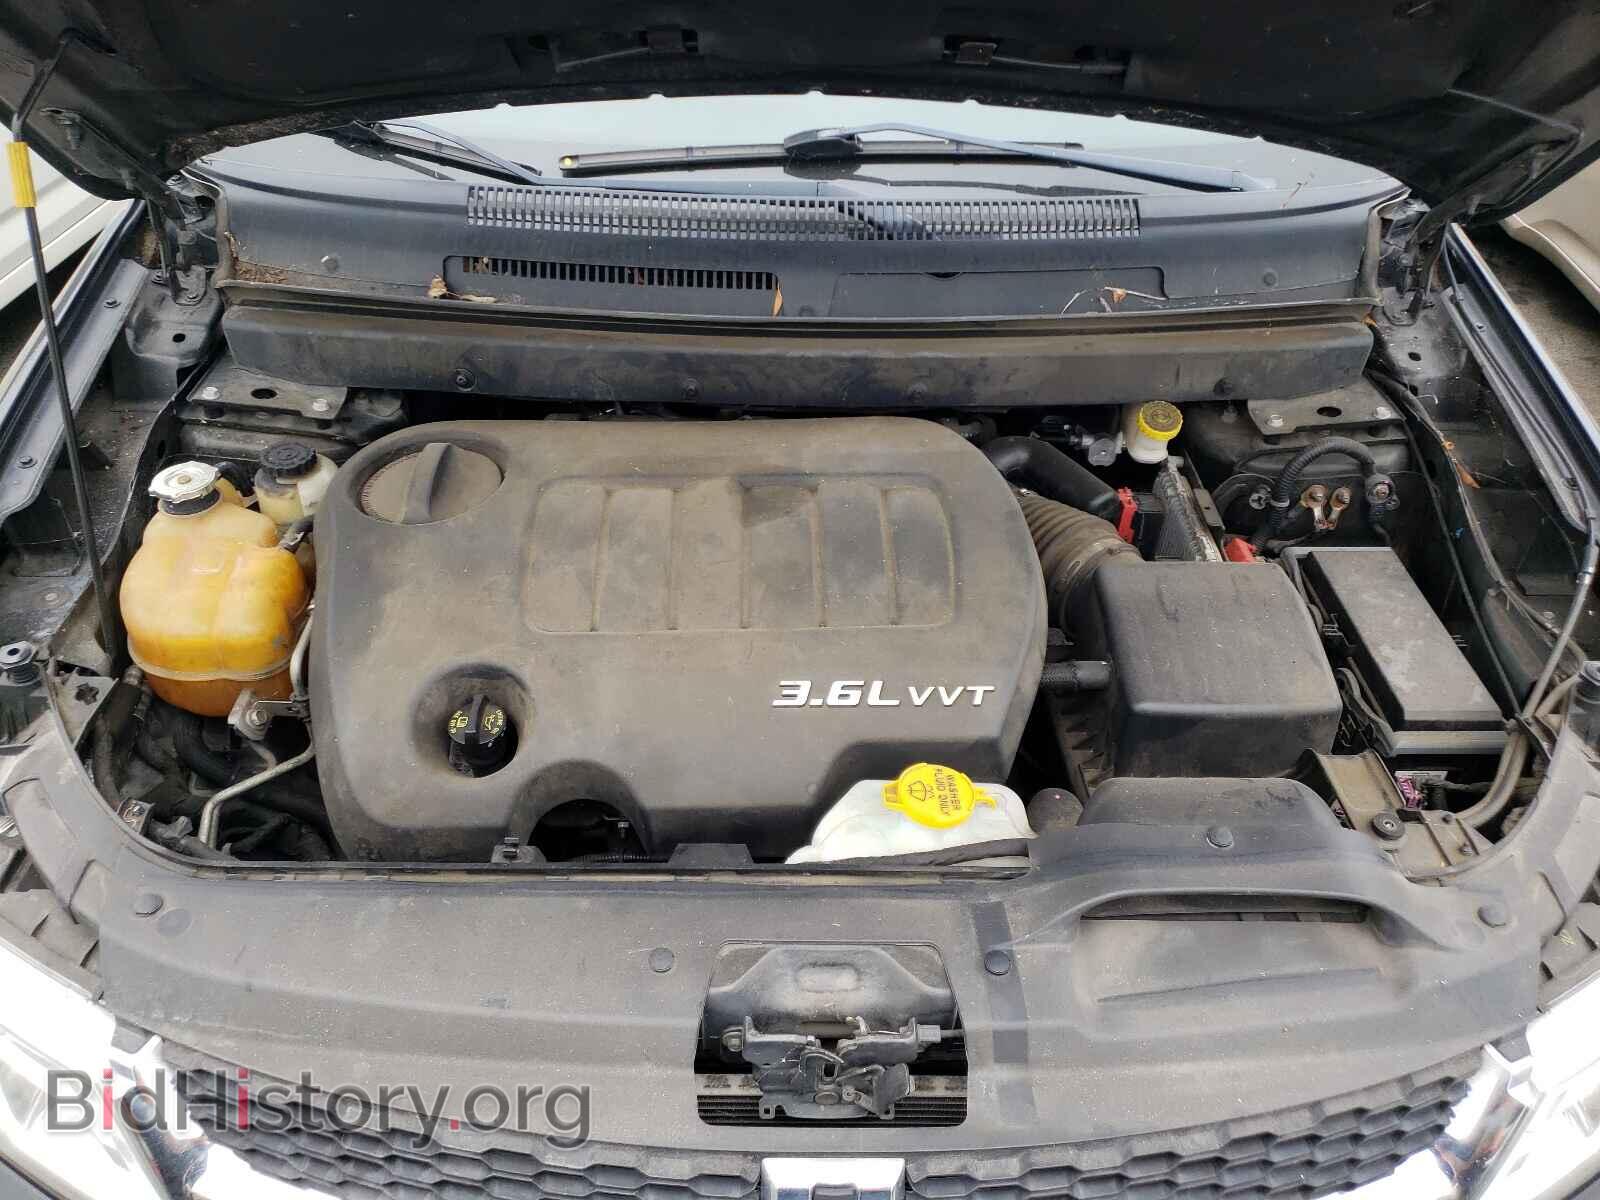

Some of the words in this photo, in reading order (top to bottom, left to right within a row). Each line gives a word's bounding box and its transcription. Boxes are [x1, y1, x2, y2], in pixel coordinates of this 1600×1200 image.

[772, 680, 901, 707] 3.6L
[907, 685, 996, 707] VVT
[934, 768, 946, 791] FLUID
[946, 774, 961, 810] WASHER
[938, 793, 951, 816] ONLY
